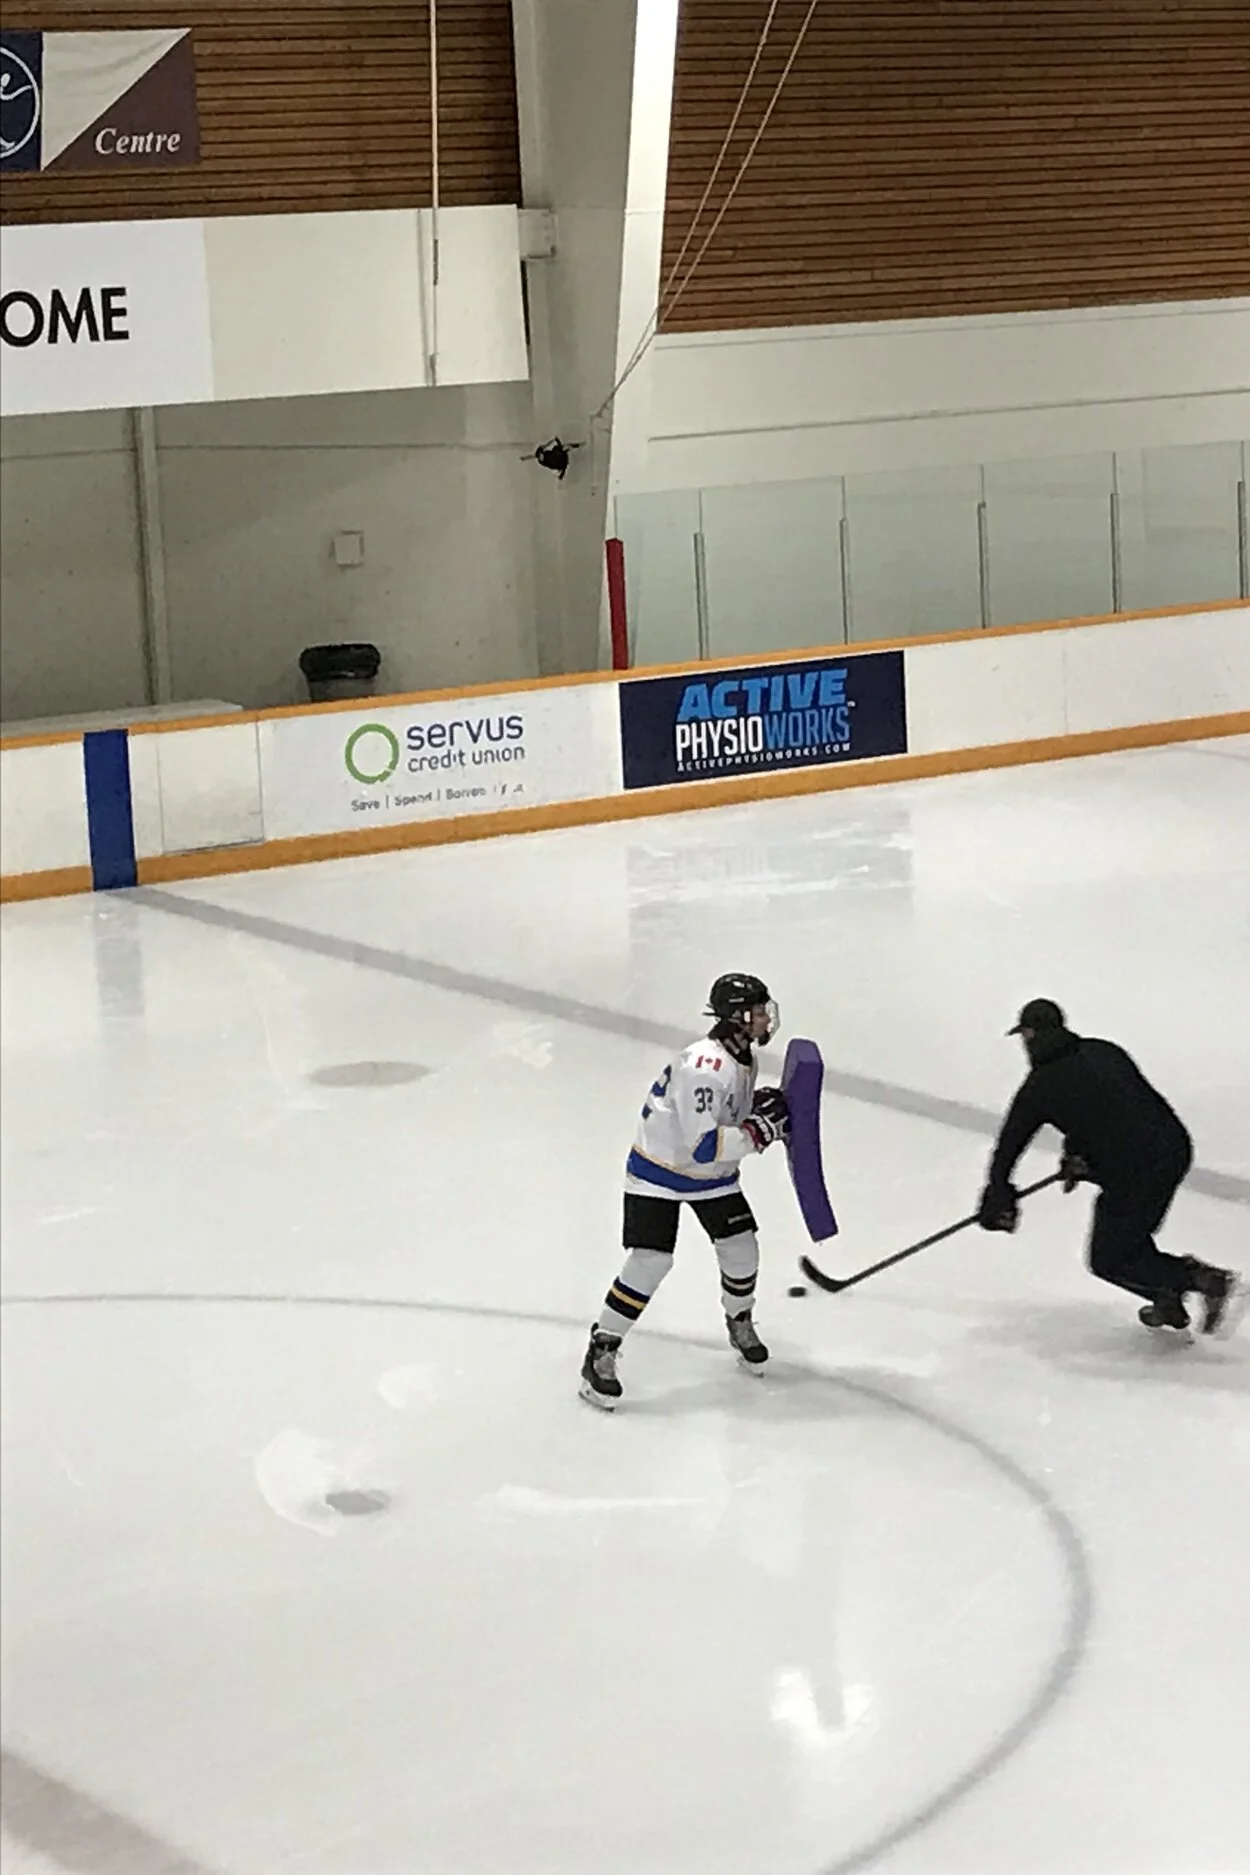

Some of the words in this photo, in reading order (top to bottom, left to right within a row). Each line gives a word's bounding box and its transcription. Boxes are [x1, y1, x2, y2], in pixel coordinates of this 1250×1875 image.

[94, 127, 181, 155] Centre
[0, 287, 130, 348] OME
[677, 668, 848, 723] ACTIVE
[406, 715, 524, 752] servus
[675, 706, 850, 763] PHYSIOWORKS
[407, 748, 466, 773] credit
[471, 746, 526, 766] union
[351, 799, 380, 812] Save
[394, 791, 433, 808] Spend
